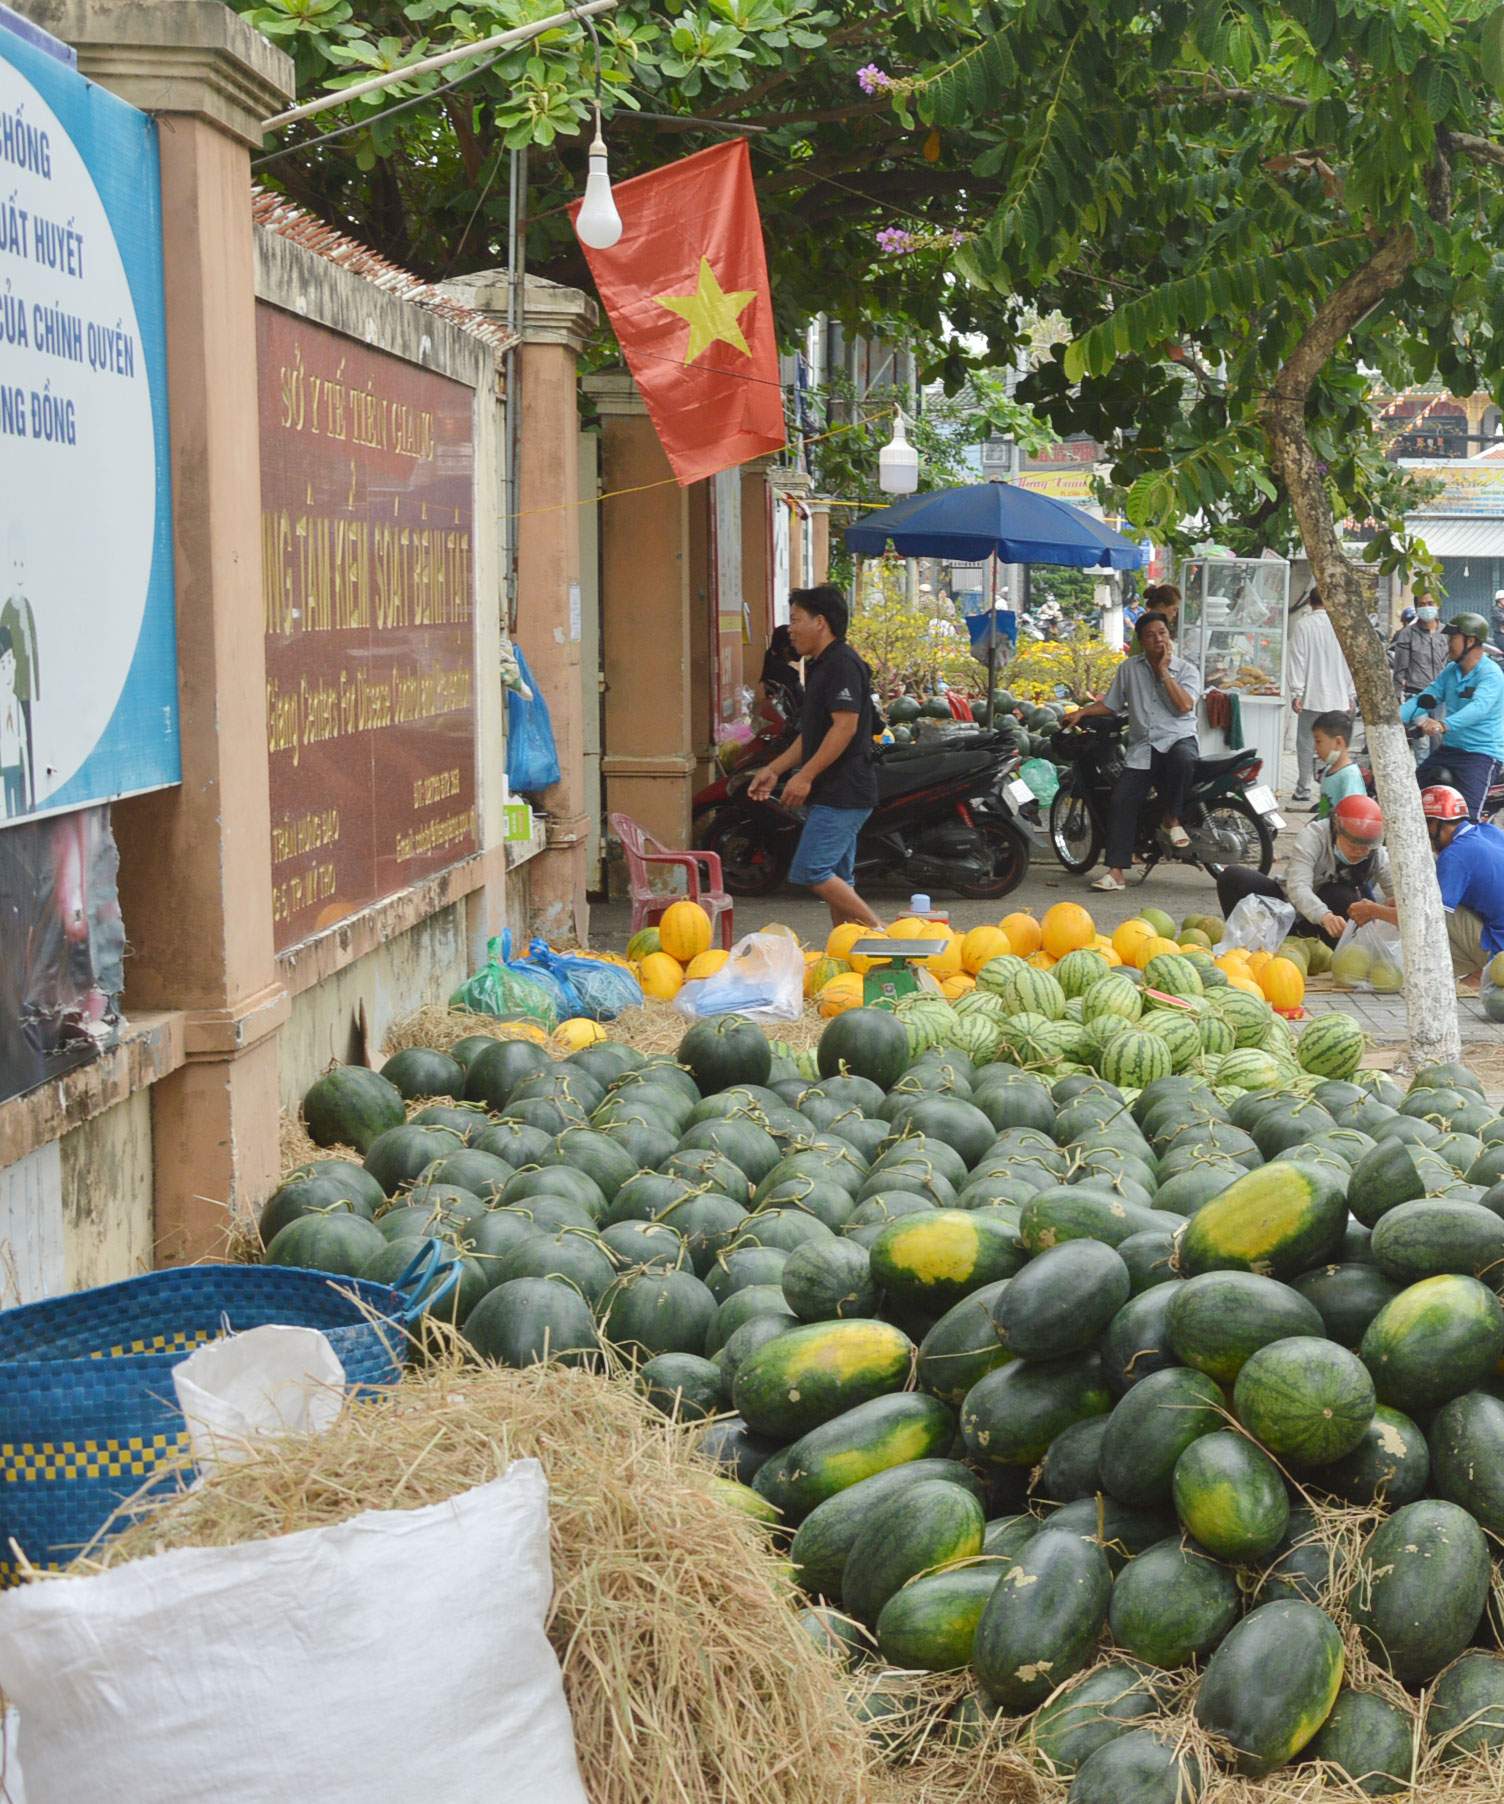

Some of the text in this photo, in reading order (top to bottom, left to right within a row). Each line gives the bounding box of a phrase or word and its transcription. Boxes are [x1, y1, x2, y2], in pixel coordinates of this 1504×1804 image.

[0, 102, 52, 181] HỐNG
[34, 216, 84, 280] HUYẾT
[33, 300, 83, 363] CHÍNH
[87, 317, 135, 378] QUYỀN
[31, 378, 76, 446] ĐỒNG
[281, 343, 305, 430] SỞ
[309, 375, 321, 433] Y
[324, 357, 346, 440] TẾ
[391, 402, 434, 461] GIANG
